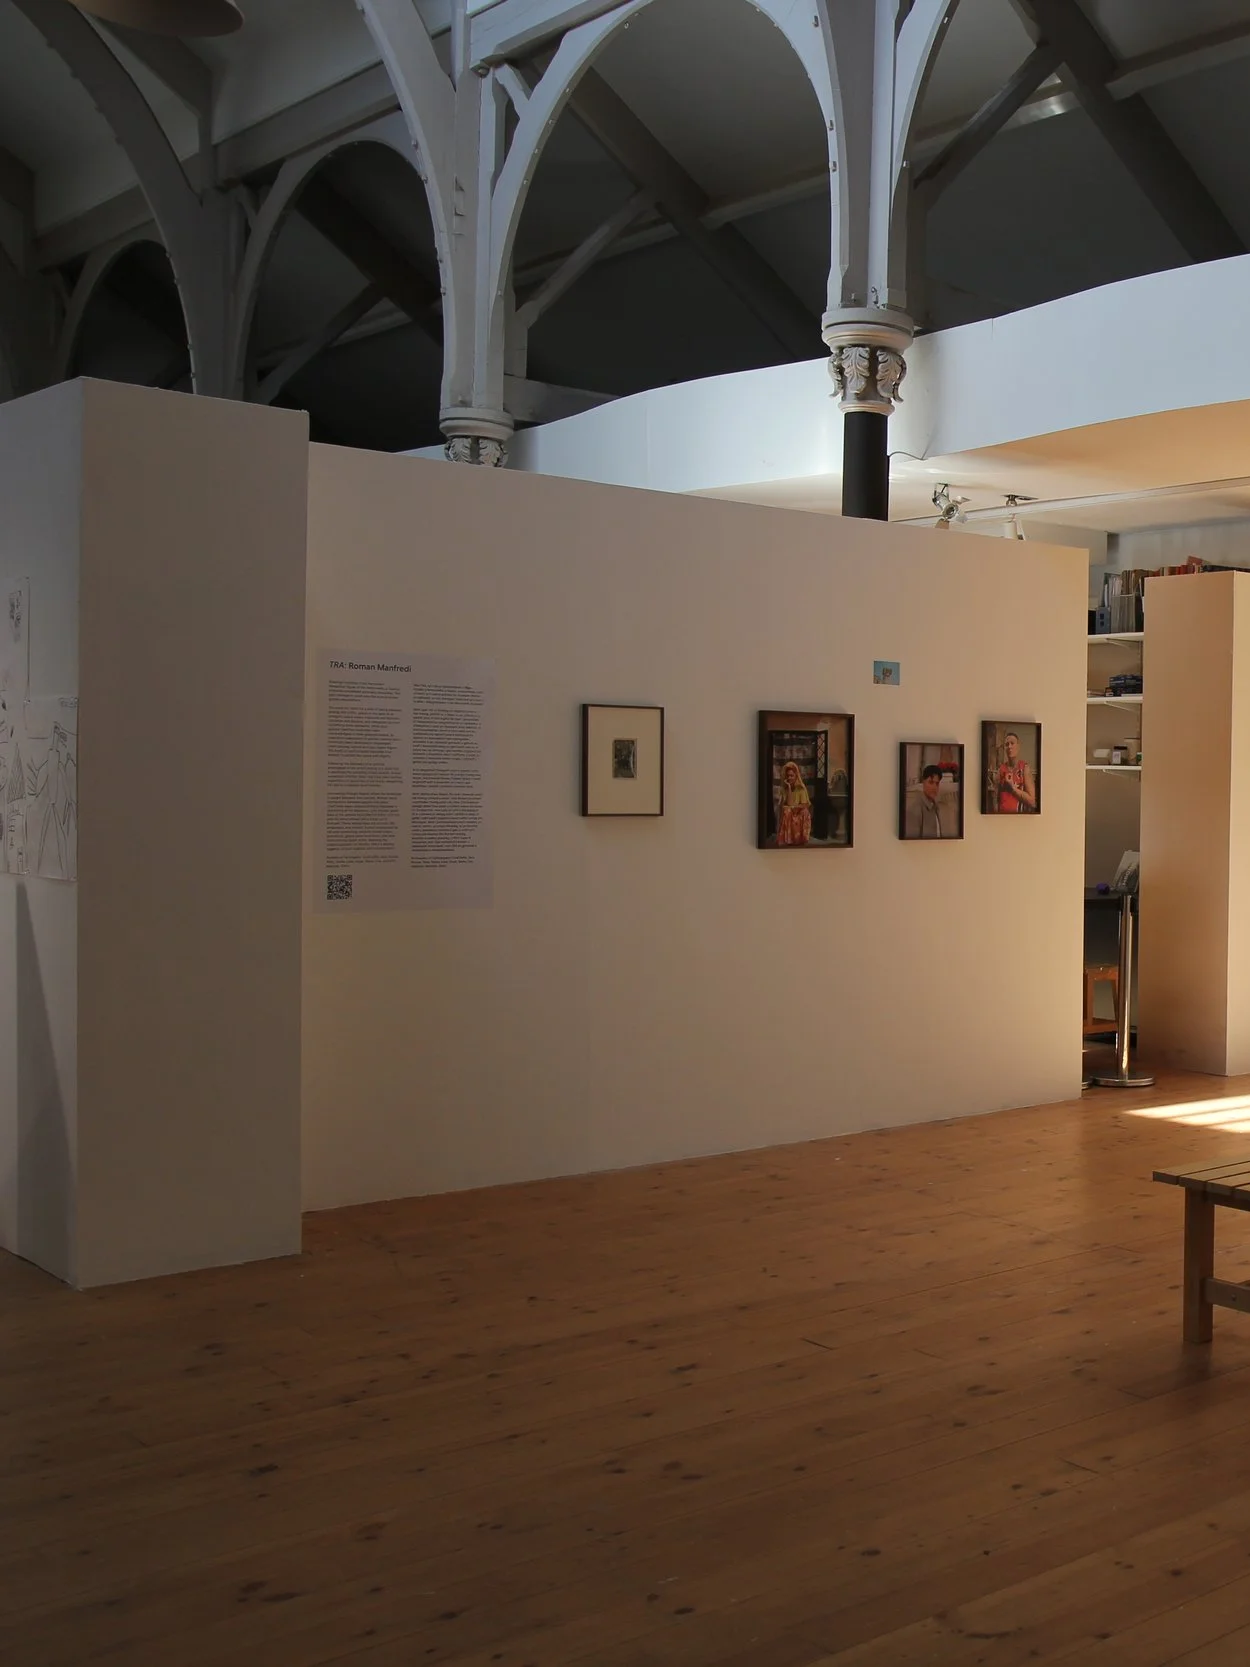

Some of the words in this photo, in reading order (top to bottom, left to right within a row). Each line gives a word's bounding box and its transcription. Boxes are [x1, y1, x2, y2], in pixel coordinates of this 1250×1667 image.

[329, 661, 347, 669] TRA:
[348, 662, 376, 671] Roman
[377, 664, 412, 673] Manfredi
